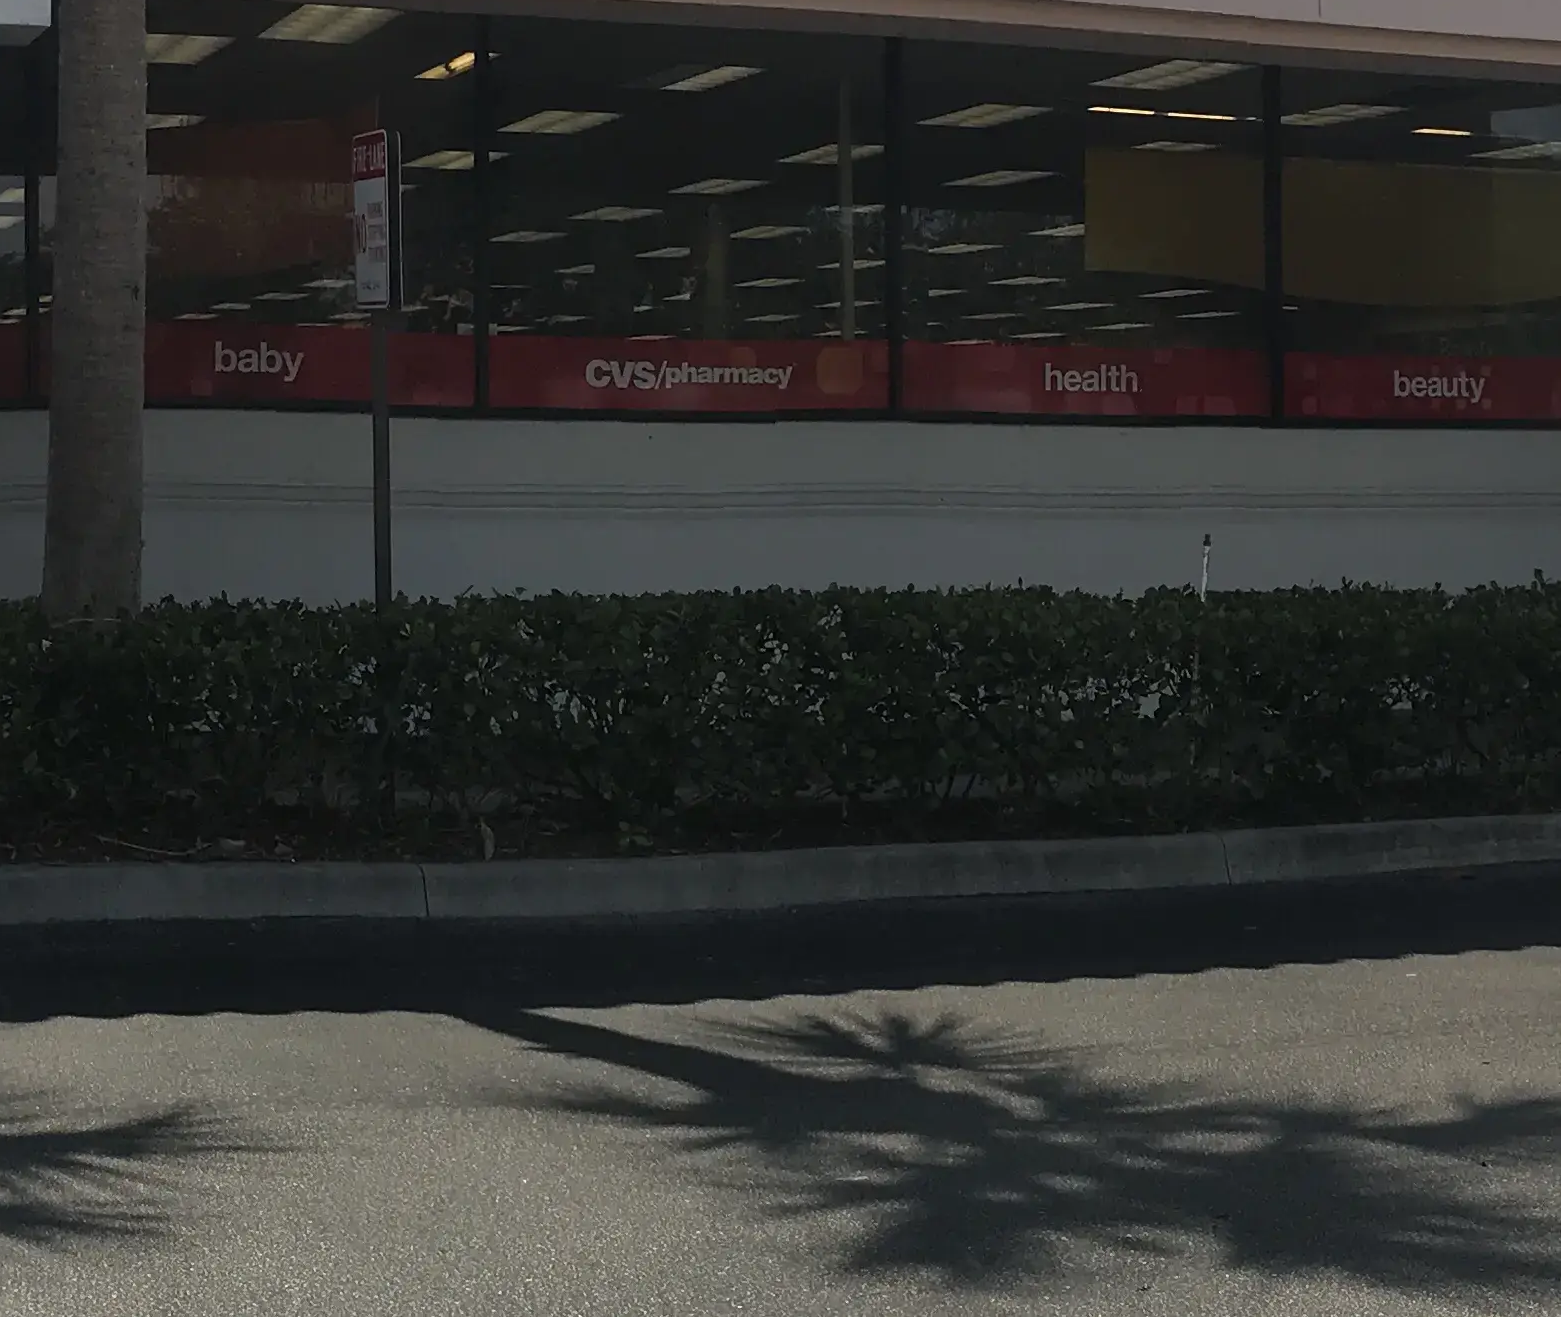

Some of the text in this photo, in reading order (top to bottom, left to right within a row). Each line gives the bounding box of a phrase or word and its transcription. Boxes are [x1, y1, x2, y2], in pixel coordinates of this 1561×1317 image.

[214, 340, 306, 383] baby
[585, 358, 794, 390] CVS/pharmacy
[1393, 370, 1486, 404] beauty
